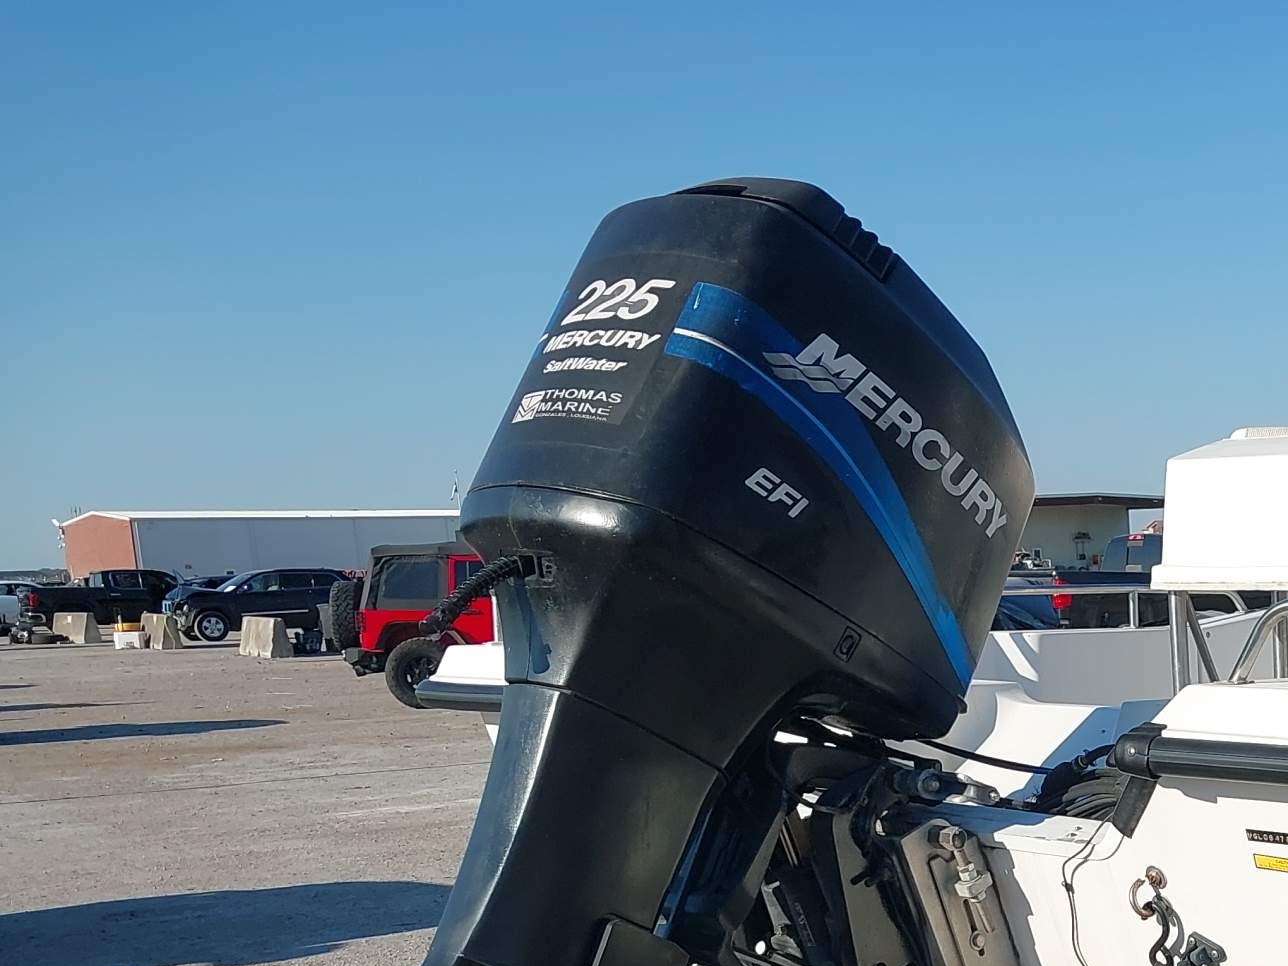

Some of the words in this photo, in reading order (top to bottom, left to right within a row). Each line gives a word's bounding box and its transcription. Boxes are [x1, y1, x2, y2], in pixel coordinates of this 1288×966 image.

[560, 278, 676, 326] 225
[543, 329, 662, 354] MERCURY
[543, 357, 628, 374] SaltWater
[537, 401, 613, 416] MARINE
[544, 388, 623, 404] THOMAS
[795, 332, 1007, 539] MERCURY
[743, 466, 809, 519] EFI
